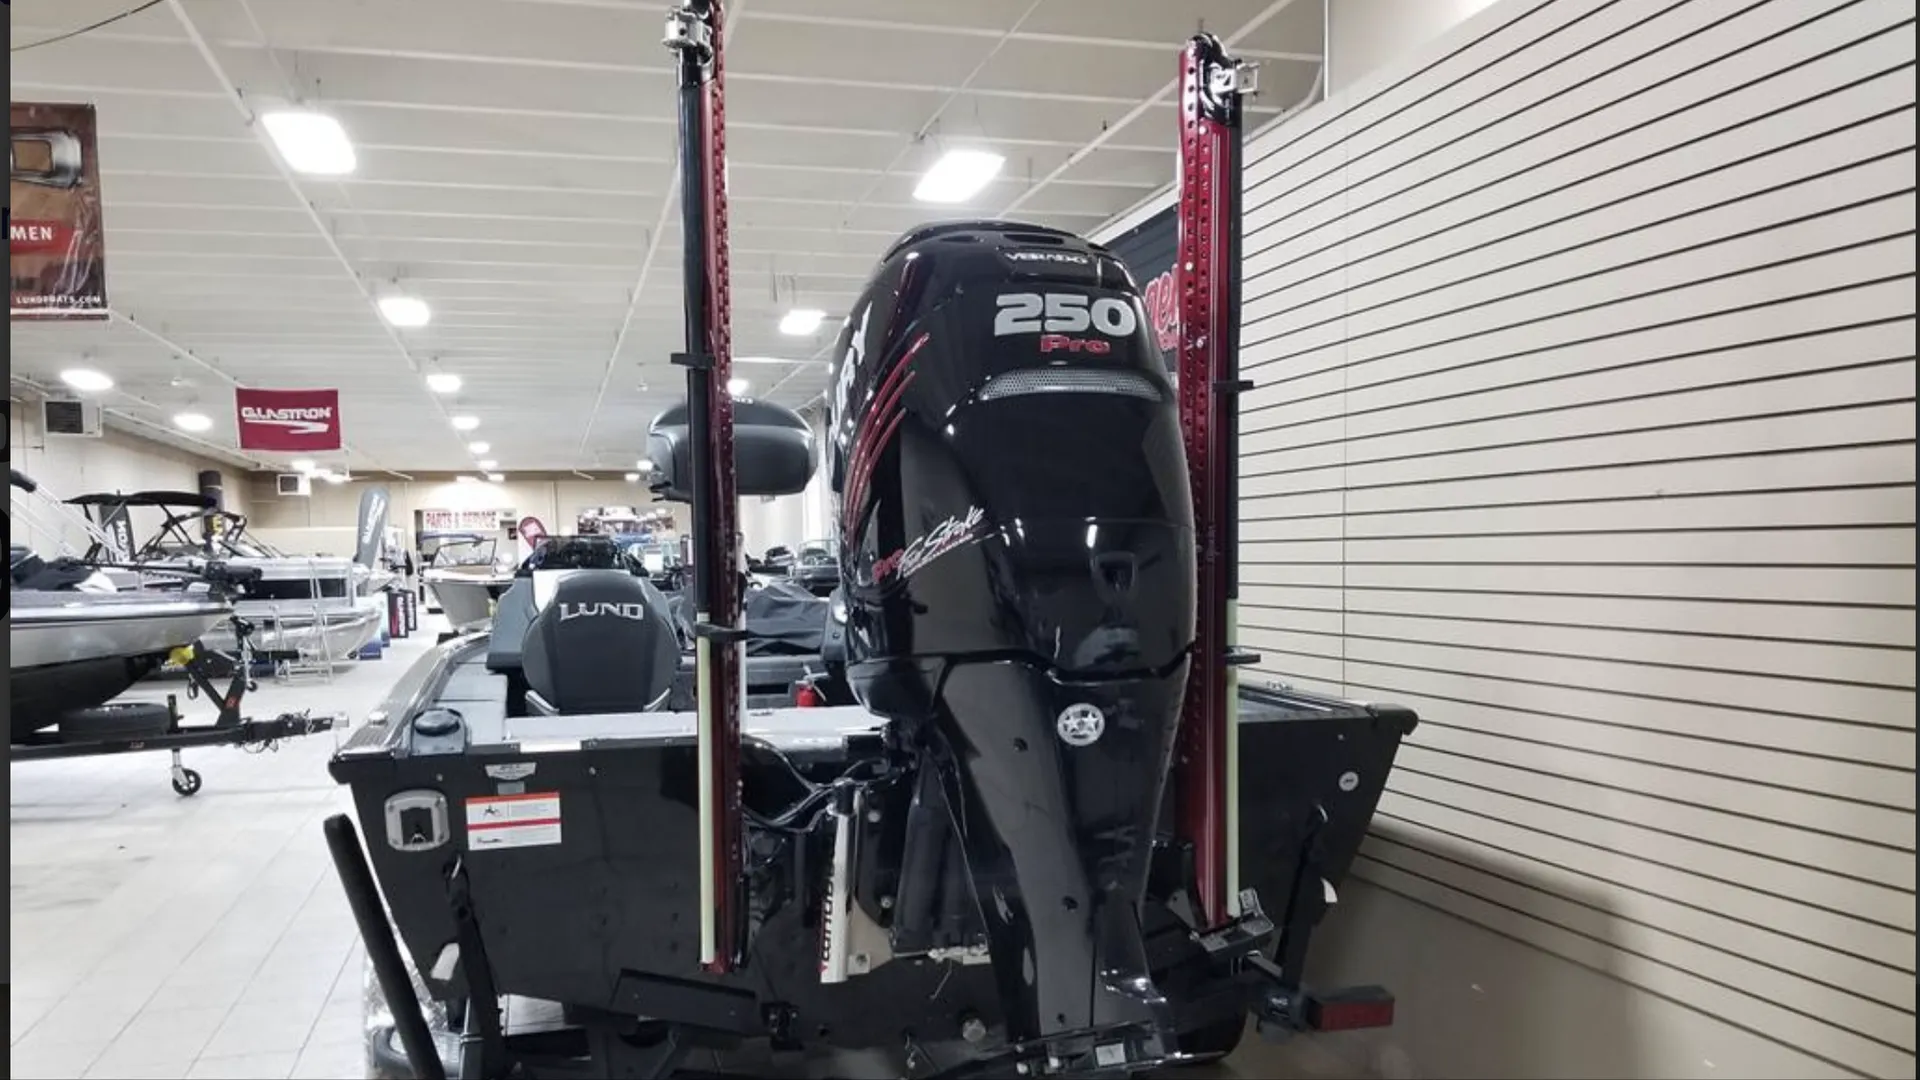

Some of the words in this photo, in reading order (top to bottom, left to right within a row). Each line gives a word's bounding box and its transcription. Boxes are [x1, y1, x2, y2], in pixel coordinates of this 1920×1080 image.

[994, 292, 1137, 338] 250
[1040, 334, 1111, 354] Pro
[559, 602, 644, 620] LUND
